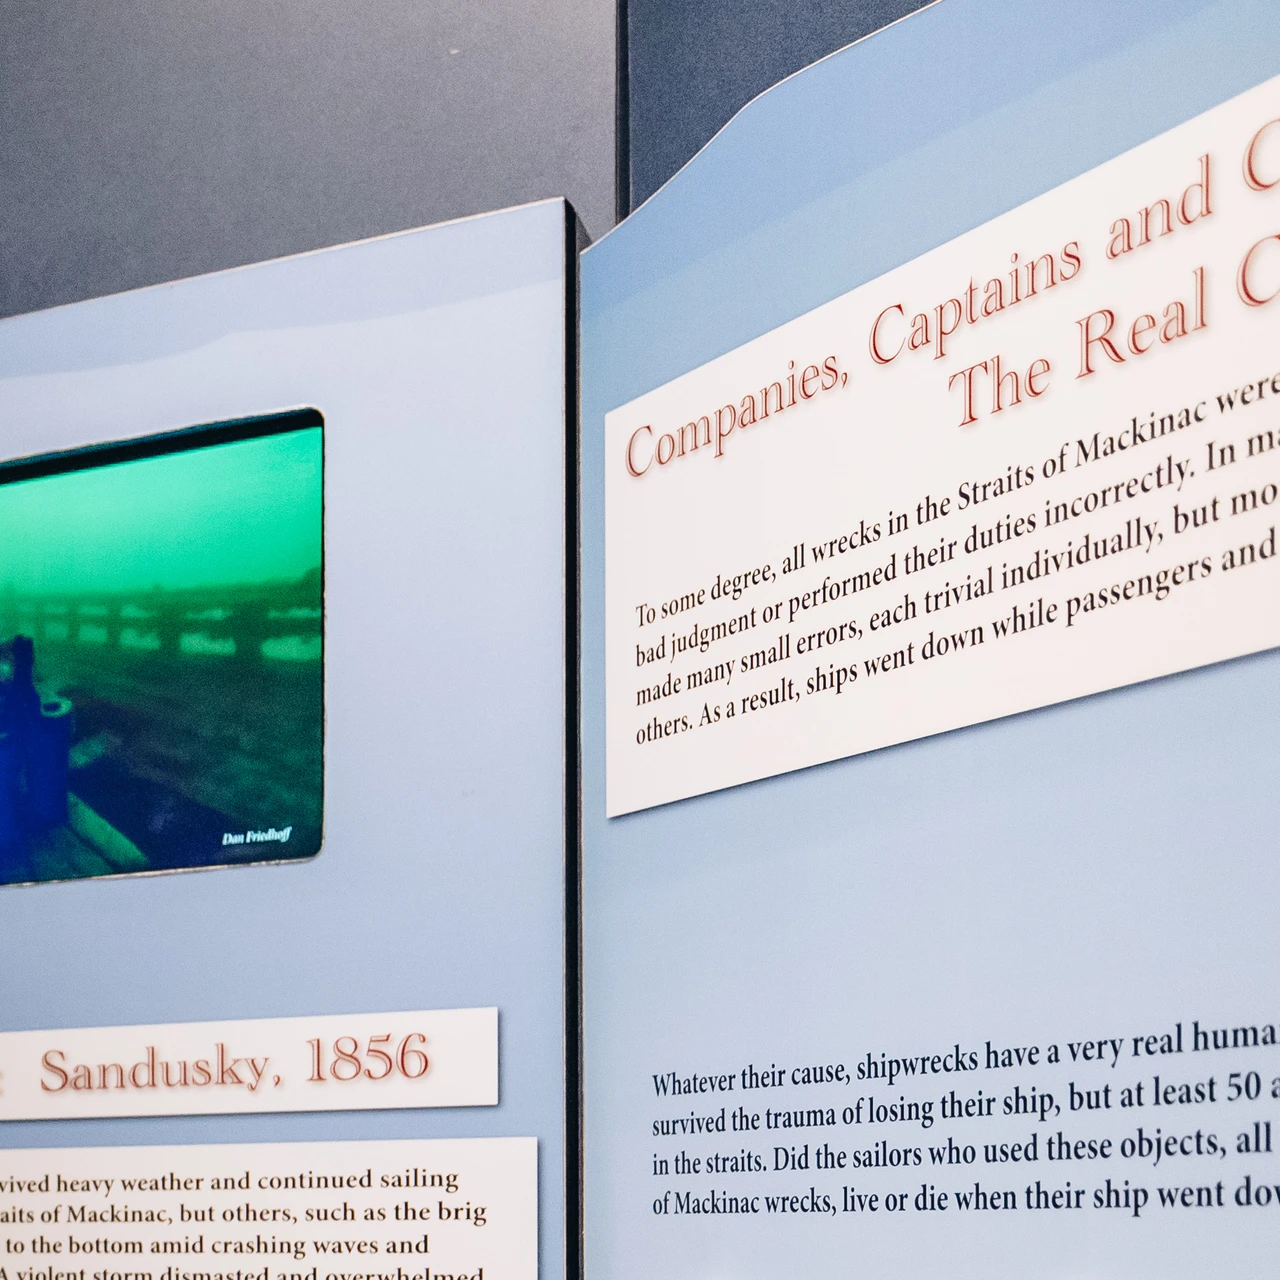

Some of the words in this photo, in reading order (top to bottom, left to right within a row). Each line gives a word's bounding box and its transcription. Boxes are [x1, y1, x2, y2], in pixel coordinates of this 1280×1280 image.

[624, 354, 849, 479] Companies,
[867, 240, 1082, 365] Captains
[1104, 152, 1214, 261] and
[947, 354, 1051, 428] The
[1073, 265, 1208, 380] Real
[635, 603, 656, 628] To
[661, 588, 706, 620] some
[710, 564, 777, 601] degree,
[782, 542, 806, 575] all
[811, 519, 882, 563] wrecks
[887, 510, 909, 537] in
[915, 494, 951, 526] the
[957, 465, 1035, 511] Straits
[1042, 442, 1070, 479] of
[1075, 405, 1207, 468] Mackinac
[636, 715, 693, 745] others.
[698, 702, 721, 728] As
[726, 701, 736, 719] a
[741, 676, 801, 715] result,
[806, 663, 858, 696] ships
[863, 641, 915, 678] went
[921, 625, 985, 661] down
[991, 597, 1058, 639] while
[1065, 556, 1212, 628] passengers
[1221, 526, 1277, 572] and
[221, 832, 245, 846] Dan
[39, 1042, 283, 1093] Sandusky,
[305, 1032, 430, 1083] 1856
[652, 1107, 727, 1137] survived
[730, 1105, 761, 1132] the
[764, 1107, 837, 1130] trauma
[841, 1096, 865, 1126] of
[867, 1095, 935, 1130] losing
[939, 1089, 997, 1120] their
[1002, 1085, 1061, 1123] ship,
[1067, 1081, 1113, 1112] but
[1120, 1081, 1145, 1109] at
[1152, 1075, 1217, 1106] least
[1226, 1070, 1262, 1102] 50
[652, 1152, 670, 1176] in
[673, 1149, 702, 1175] the
[705, 1148, 768, 1174] straits.
[772, 1143, 811, 1172] Did
[814, 1142, 848, 1170] the
[852, 1139, 923, 1169] sailors
[927, 1136, 977, 1166] who
[983, 1132, 1040, 1164] used
[1045, 1130, 1113, 1162] these
[1120, 1127, 1227, 1168] objects,
[1236, 1120, 1273, 1154] all
[40, 1204, 63, 1224] of
[66, 1204, 173, 1225] Mackinac,
[179, 1203, 215, 1223] but
[221, 1202, 298, 1225] others,
[304, 1201, 356, 1222] such
[363, 1207, 387, 1222] as
[393, 1200, 431, 1221] the
[437, 1200, 487, 1227] brig
[56, 1173, 115, 1198] heavy
[120, 1171, 205, 1192] weather
[210, 1170, 251, 1191] and
[257, 1168, 373, 1190] continued
[380, 1167, 459, 1194] sailing
